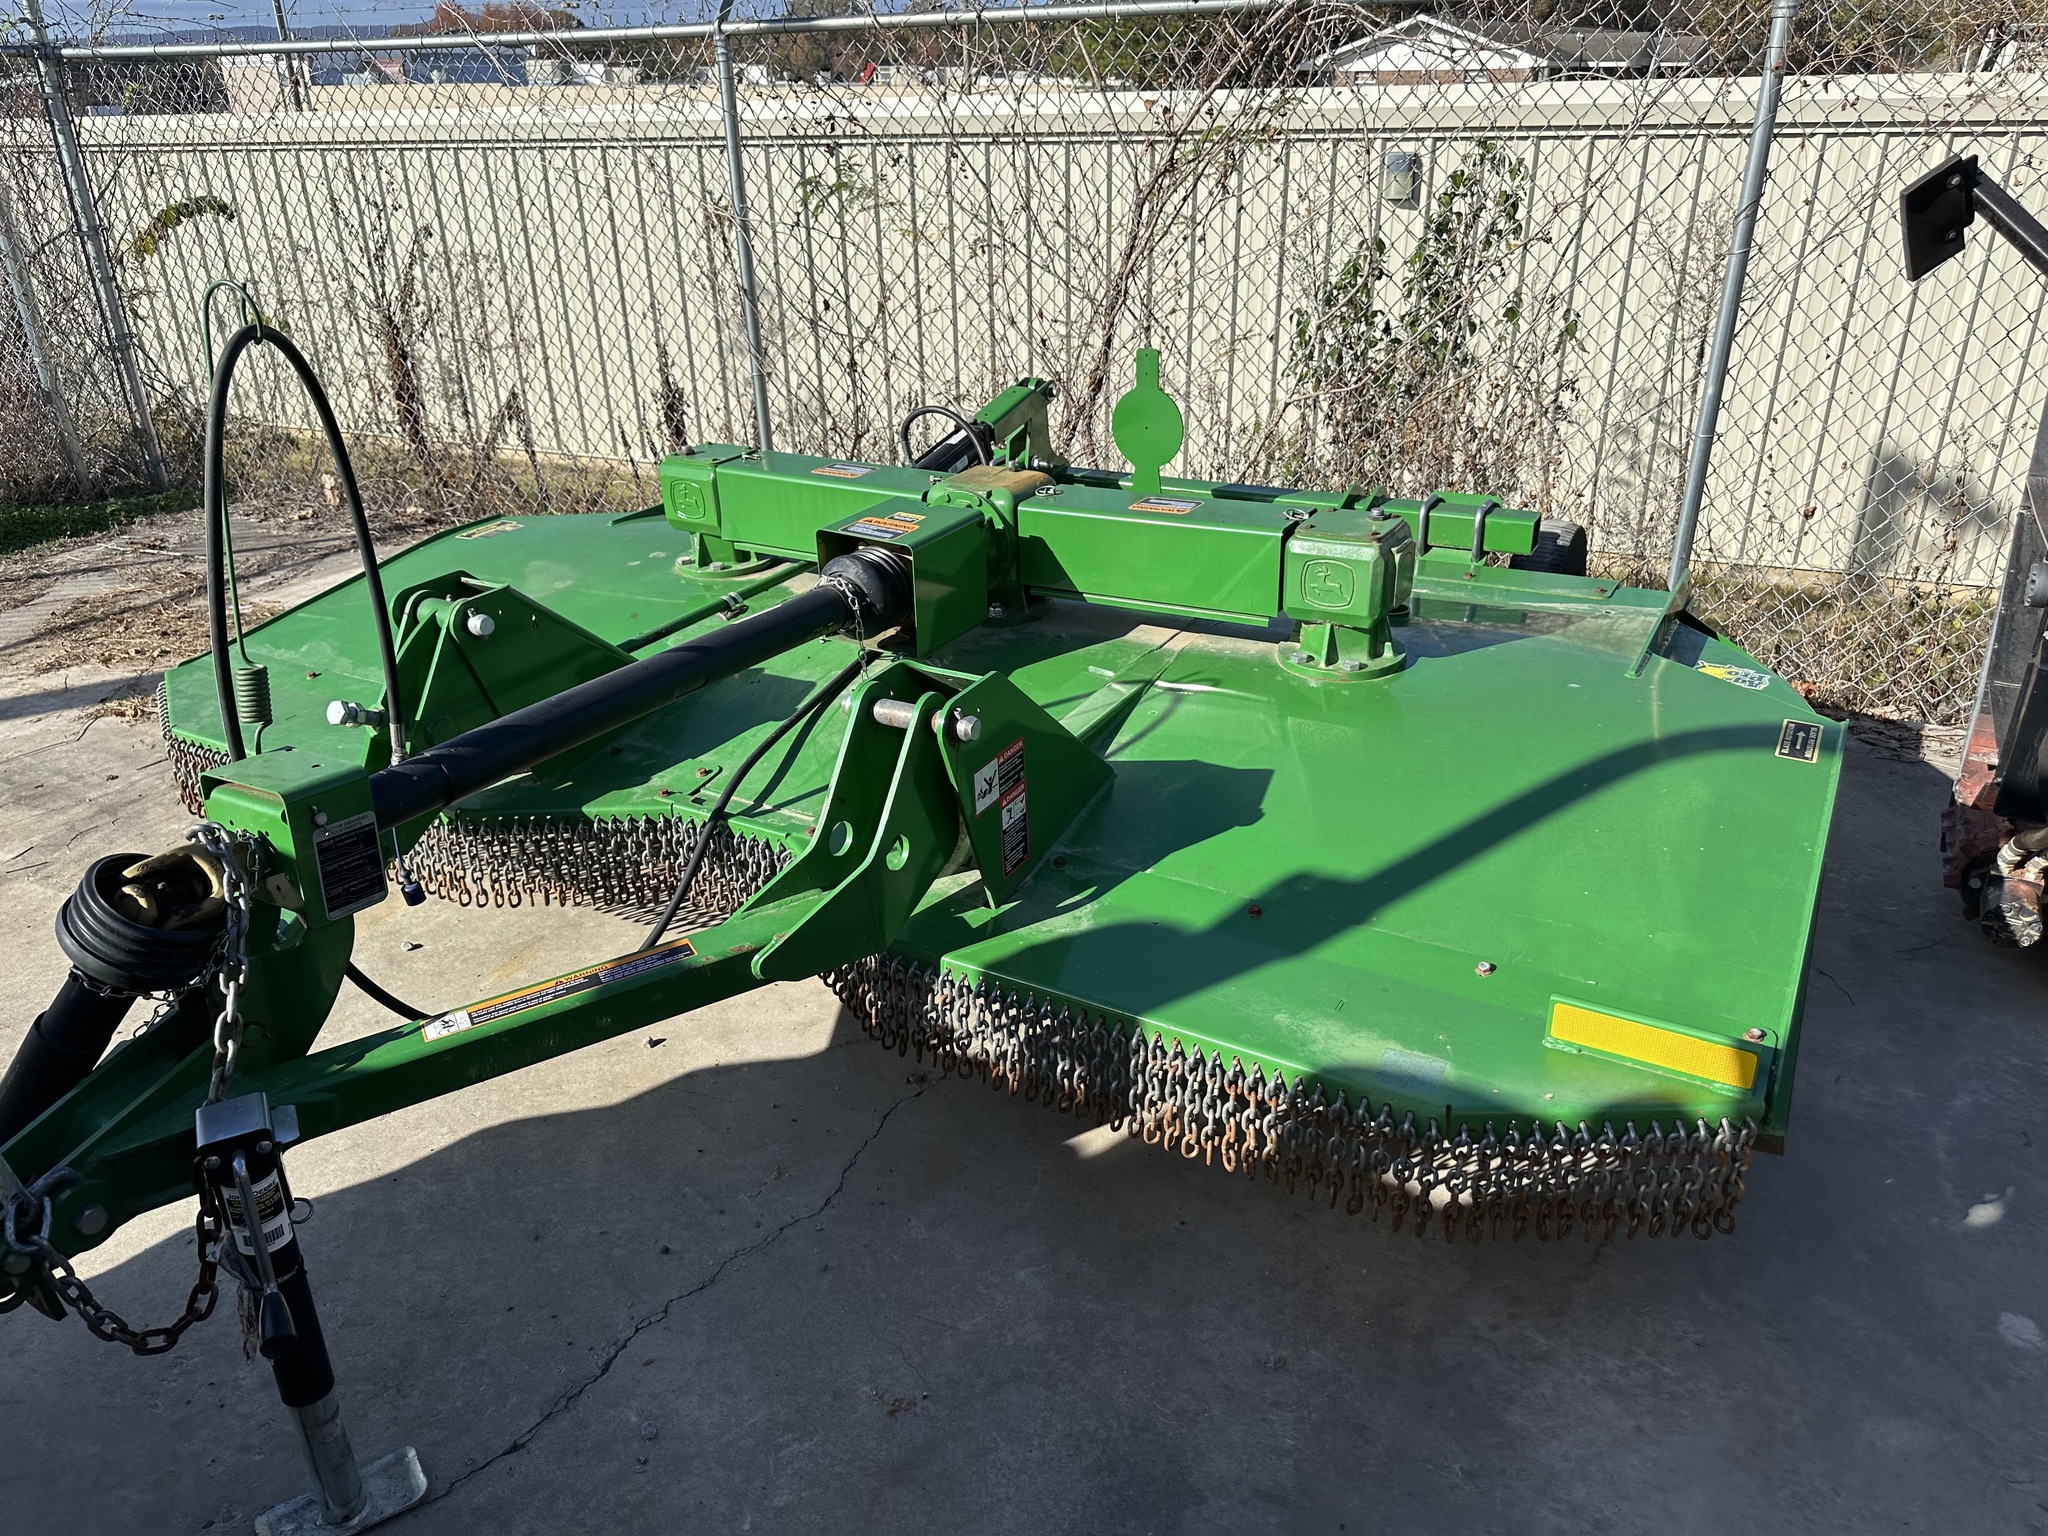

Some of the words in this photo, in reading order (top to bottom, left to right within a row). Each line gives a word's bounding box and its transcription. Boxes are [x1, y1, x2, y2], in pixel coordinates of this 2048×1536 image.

[874, 518, 916, 530] WARNING
[1003, 740, 1024, 760] DANGER
[1006, 782, 1026, 803] DANGER
[563, 965, 609, 982] WARNING
